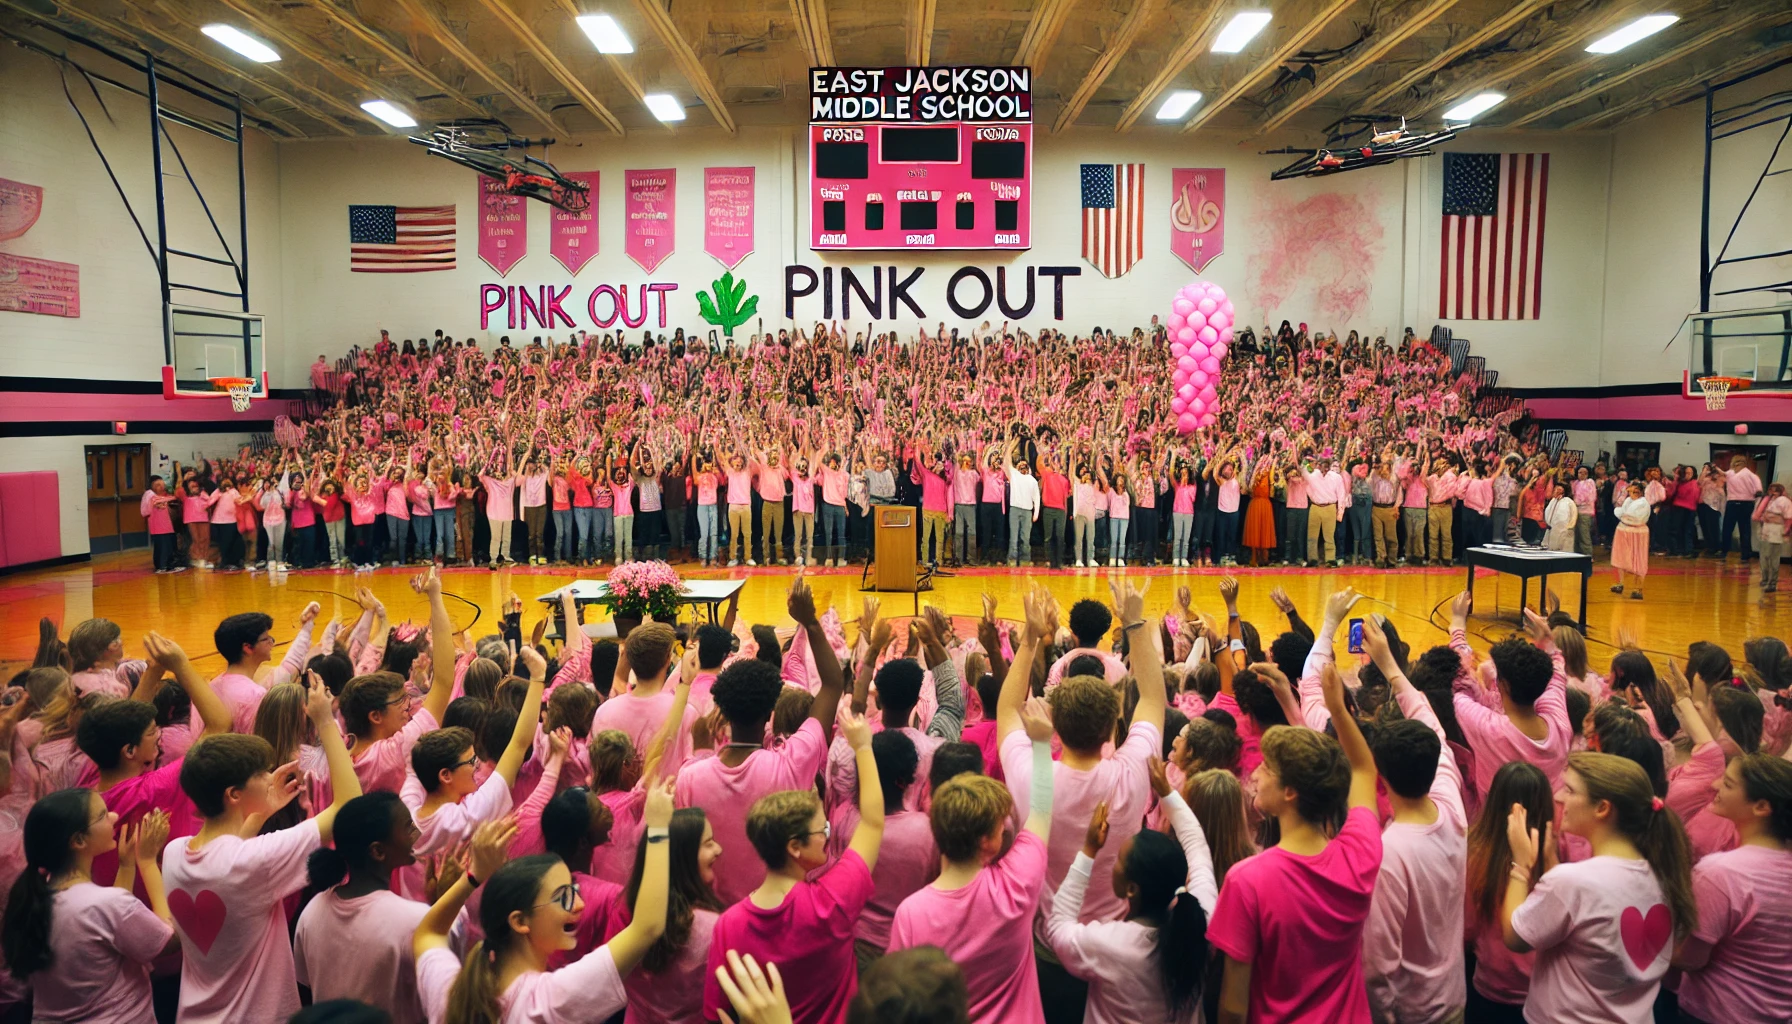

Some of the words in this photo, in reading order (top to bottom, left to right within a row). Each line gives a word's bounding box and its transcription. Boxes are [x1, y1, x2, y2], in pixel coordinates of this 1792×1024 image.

[813, 70, 884, 93] EAST
[895, 68, 1029, 93] JACKSON
[812, 96, 910, 119] MIDDLE
[921, 95, 1030, 119] SCHOOL
[480, 283, 577, 330] PINK
[588, 283, 679, 329] OUT
[785, 265, 926, 320] PINK
[946, 266, 1082, 320] OUT
